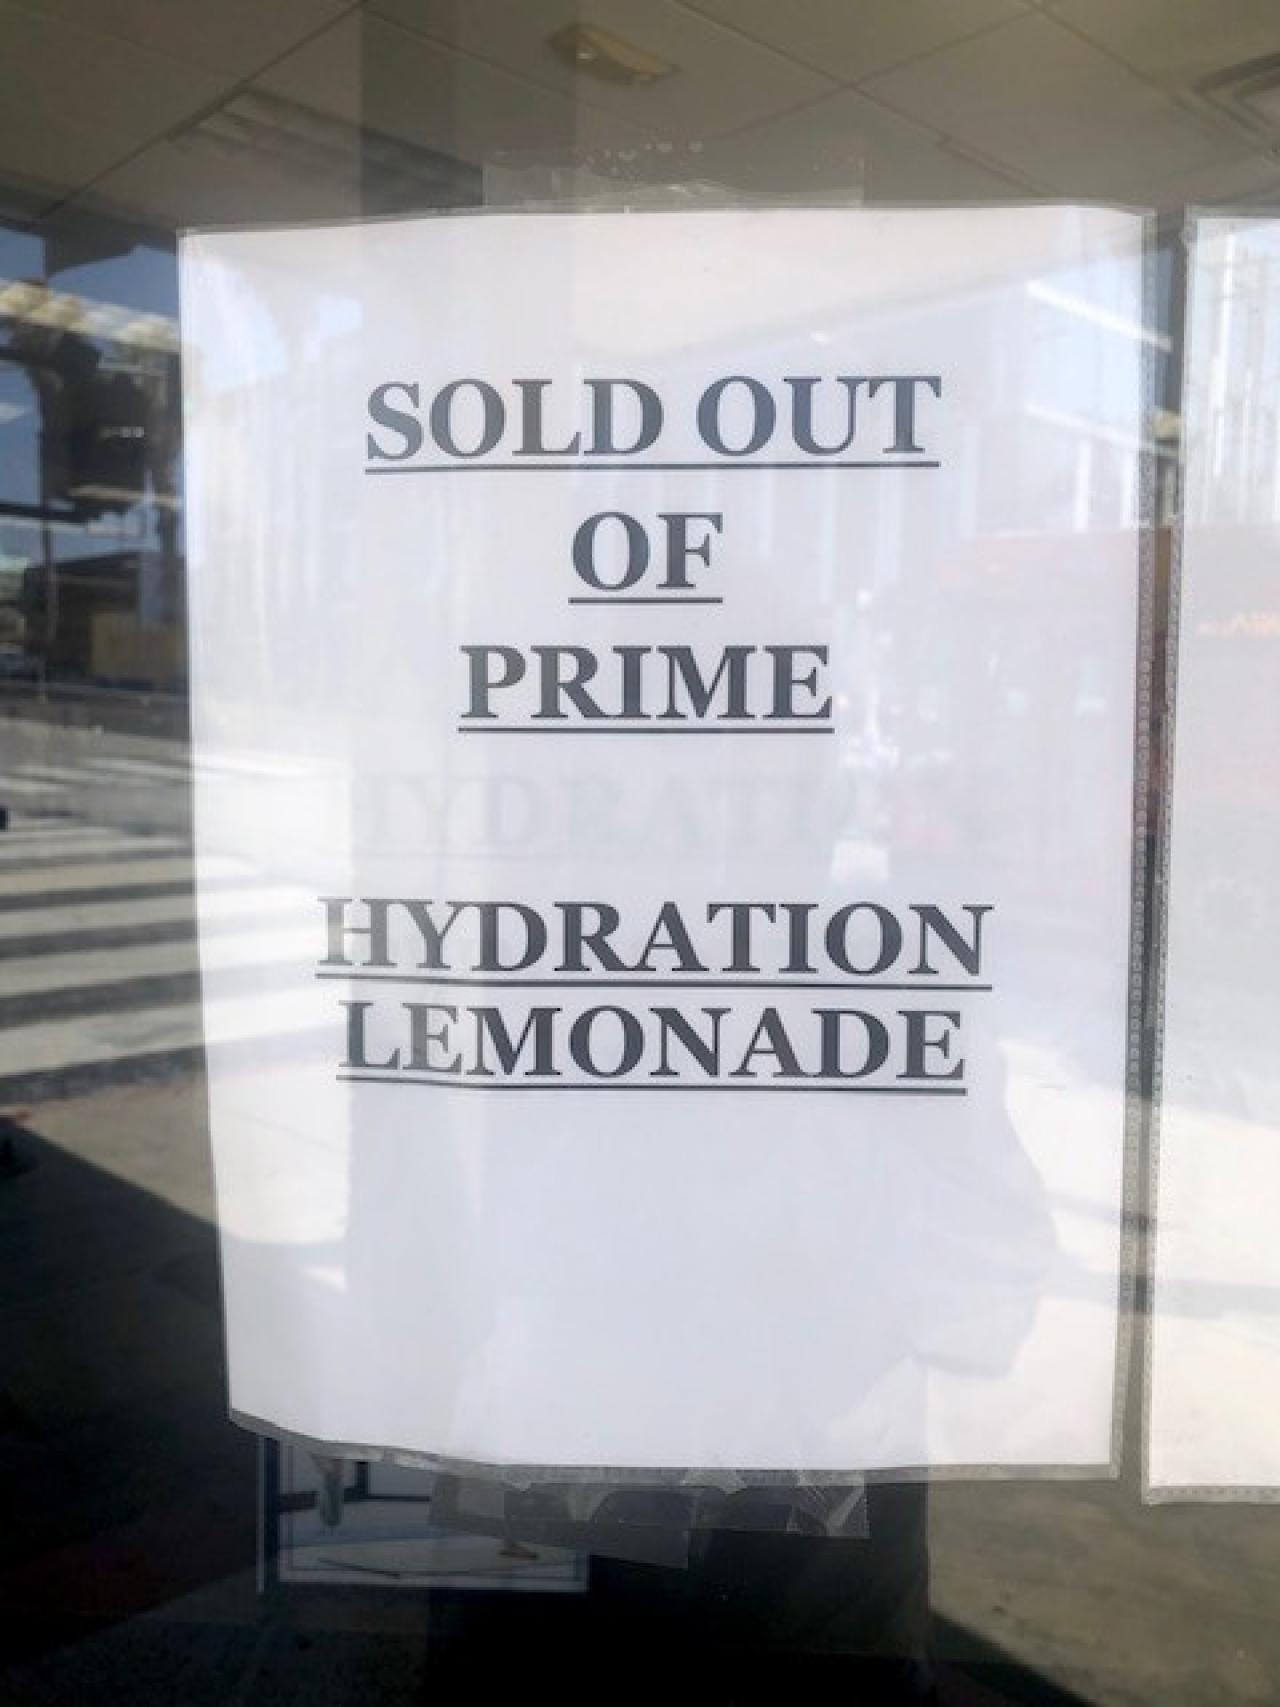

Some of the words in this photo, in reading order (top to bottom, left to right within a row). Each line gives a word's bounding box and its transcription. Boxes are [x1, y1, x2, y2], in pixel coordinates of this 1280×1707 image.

[366, 376, 662, 460] SOLD
[697, 375, 941, 457] OUT
[572, 511, 723, 591] OF
[460, 645, 833, 721] PRIME
[318, 897, 995, 977] HYDRATION
[340, 1001, 967, 1081] LEMONADE
